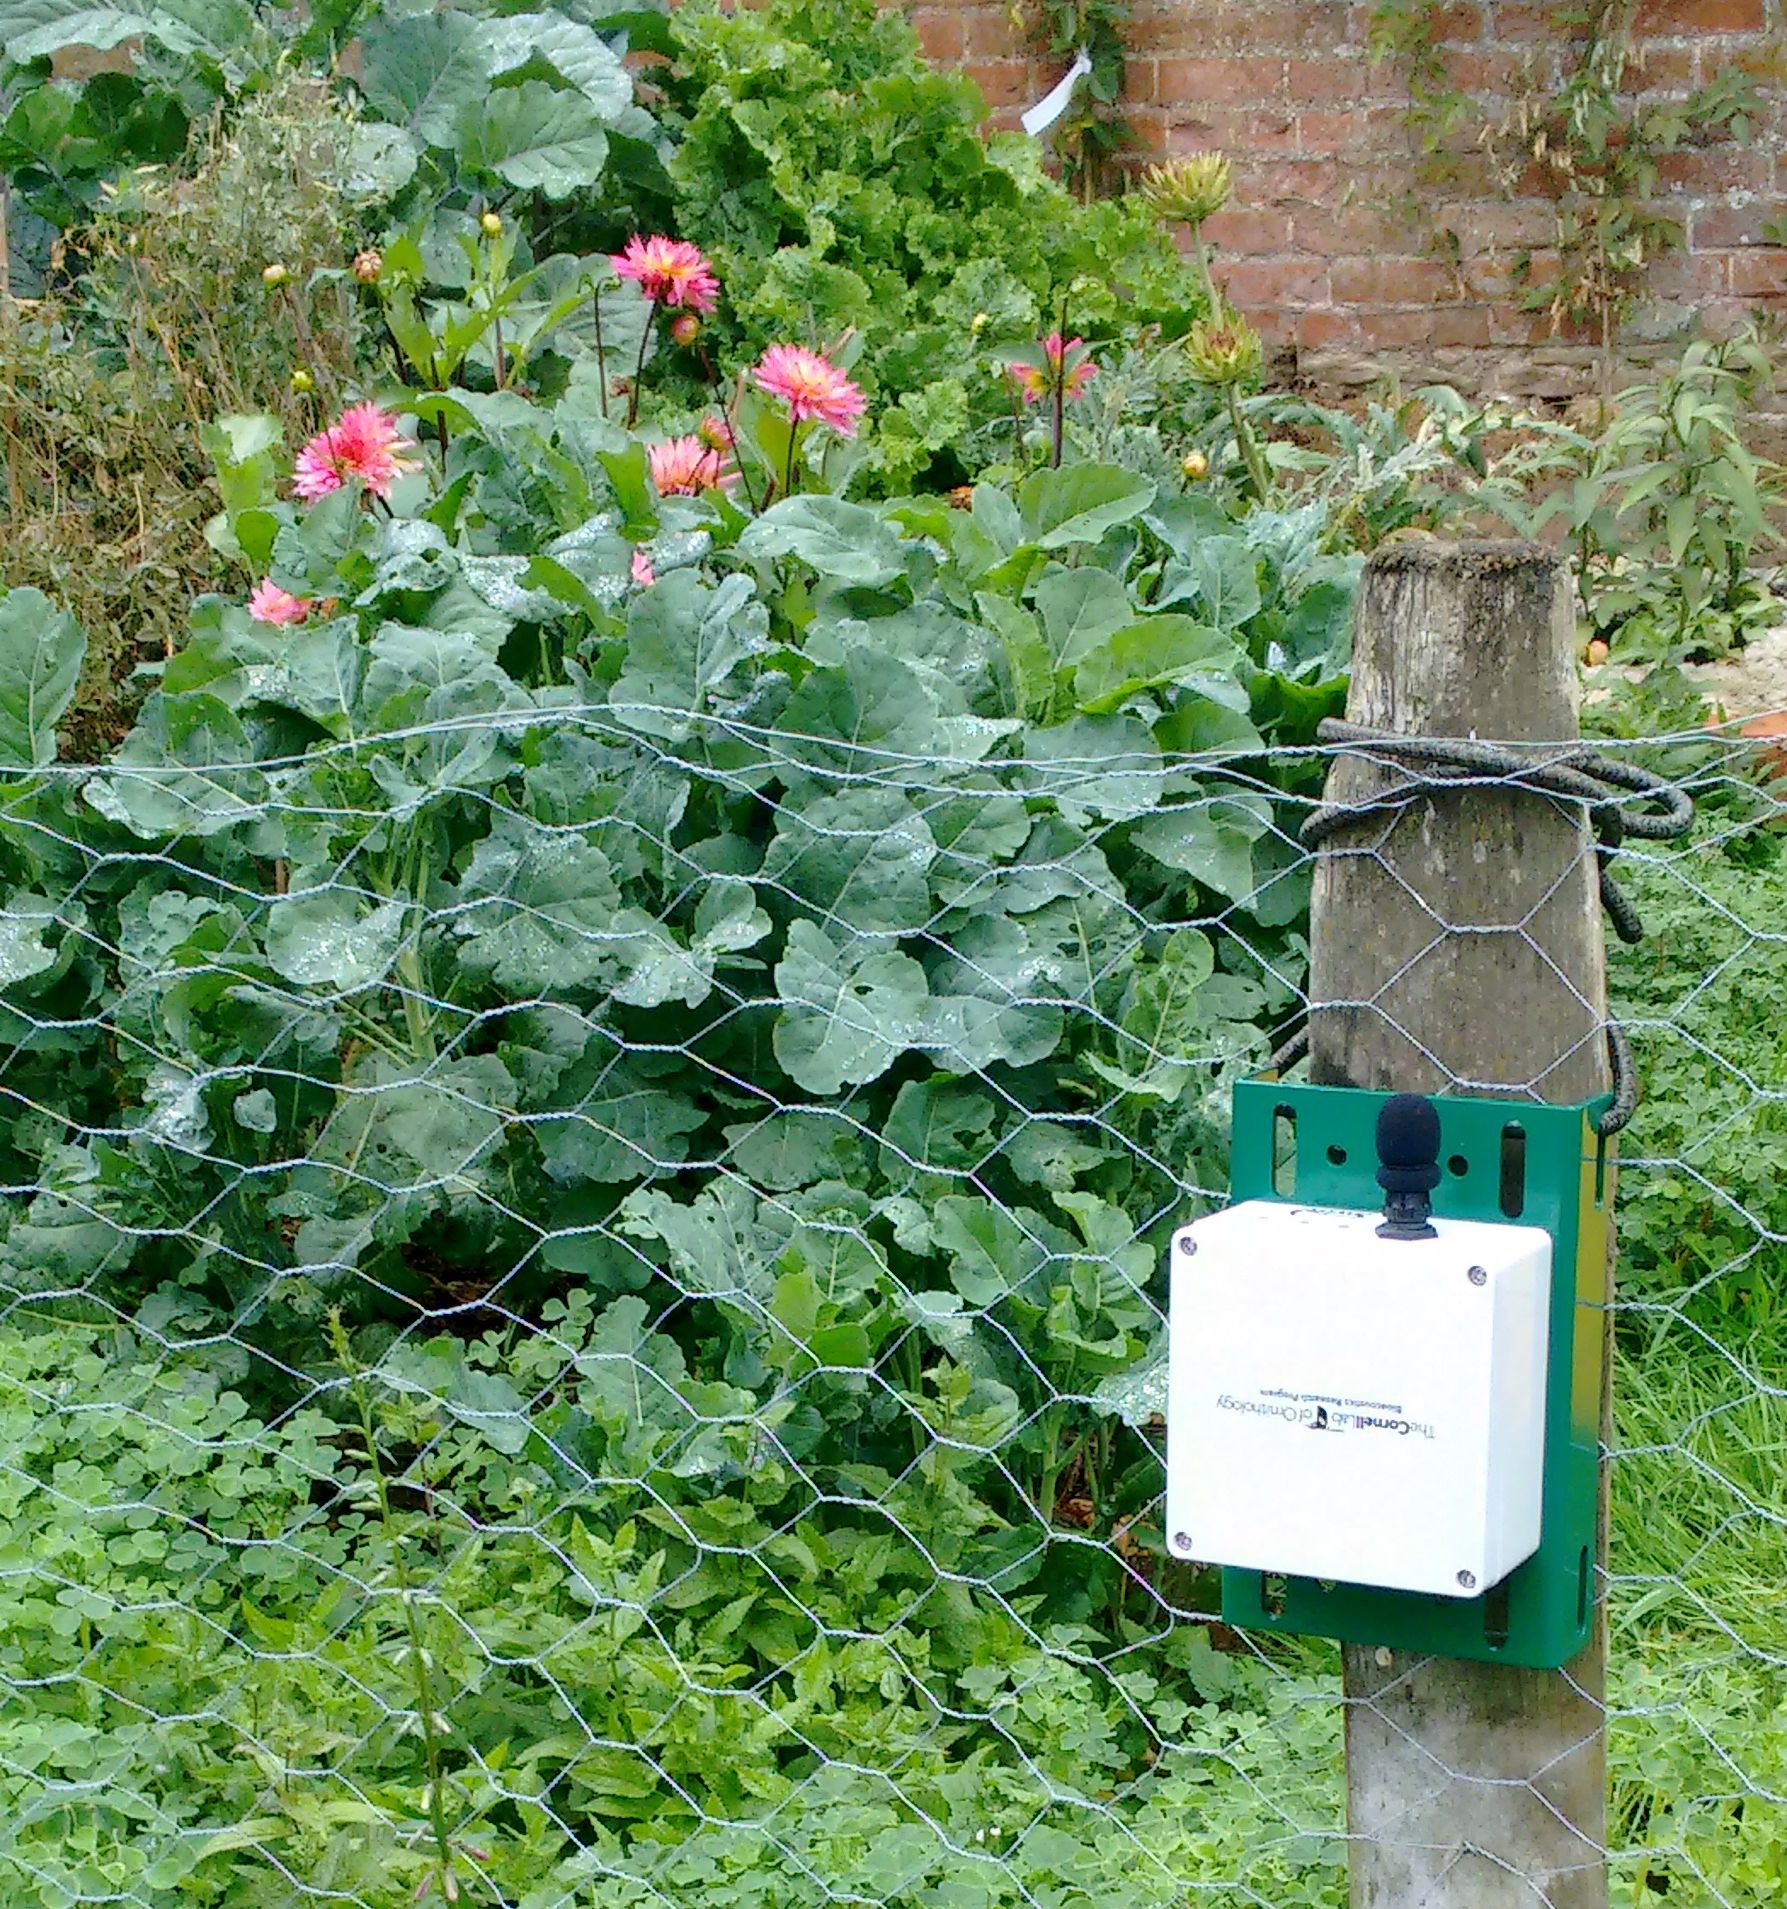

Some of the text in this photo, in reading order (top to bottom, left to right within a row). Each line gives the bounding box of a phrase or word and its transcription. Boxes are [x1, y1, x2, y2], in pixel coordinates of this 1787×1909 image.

[1216, 1394, 1297, 1422] Ornithology
[1344, 1399, 1402, 1414] Bioacoustics
[1298, 1408, 1312, 1422] of
